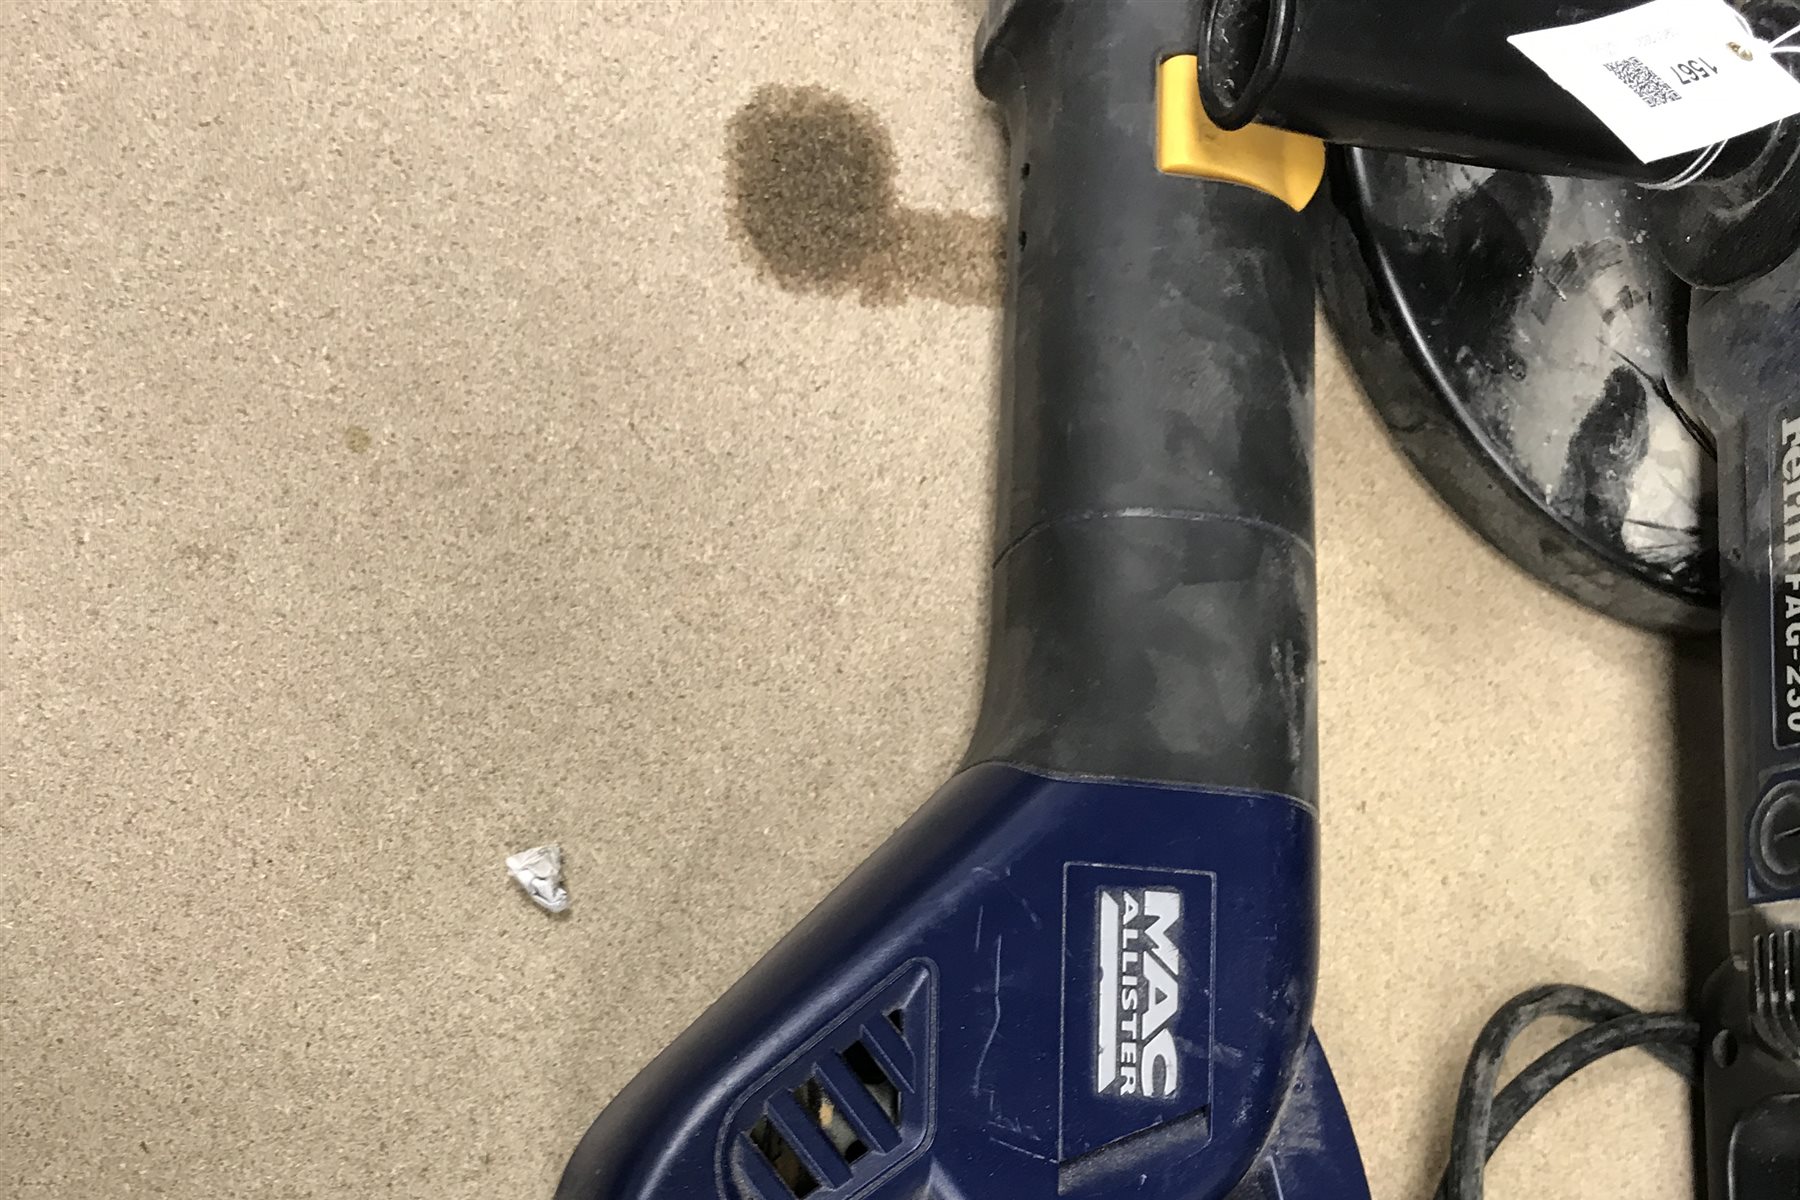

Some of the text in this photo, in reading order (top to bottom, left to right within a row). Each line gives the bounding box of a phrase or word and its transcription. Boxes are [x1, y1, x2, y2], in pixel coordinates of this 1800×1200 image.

[1669, 57, 1719, 86] 1567
[1119, 890, 1139, 1097] ALLISTER
[1141, 890, 1181, 1098] MAC
